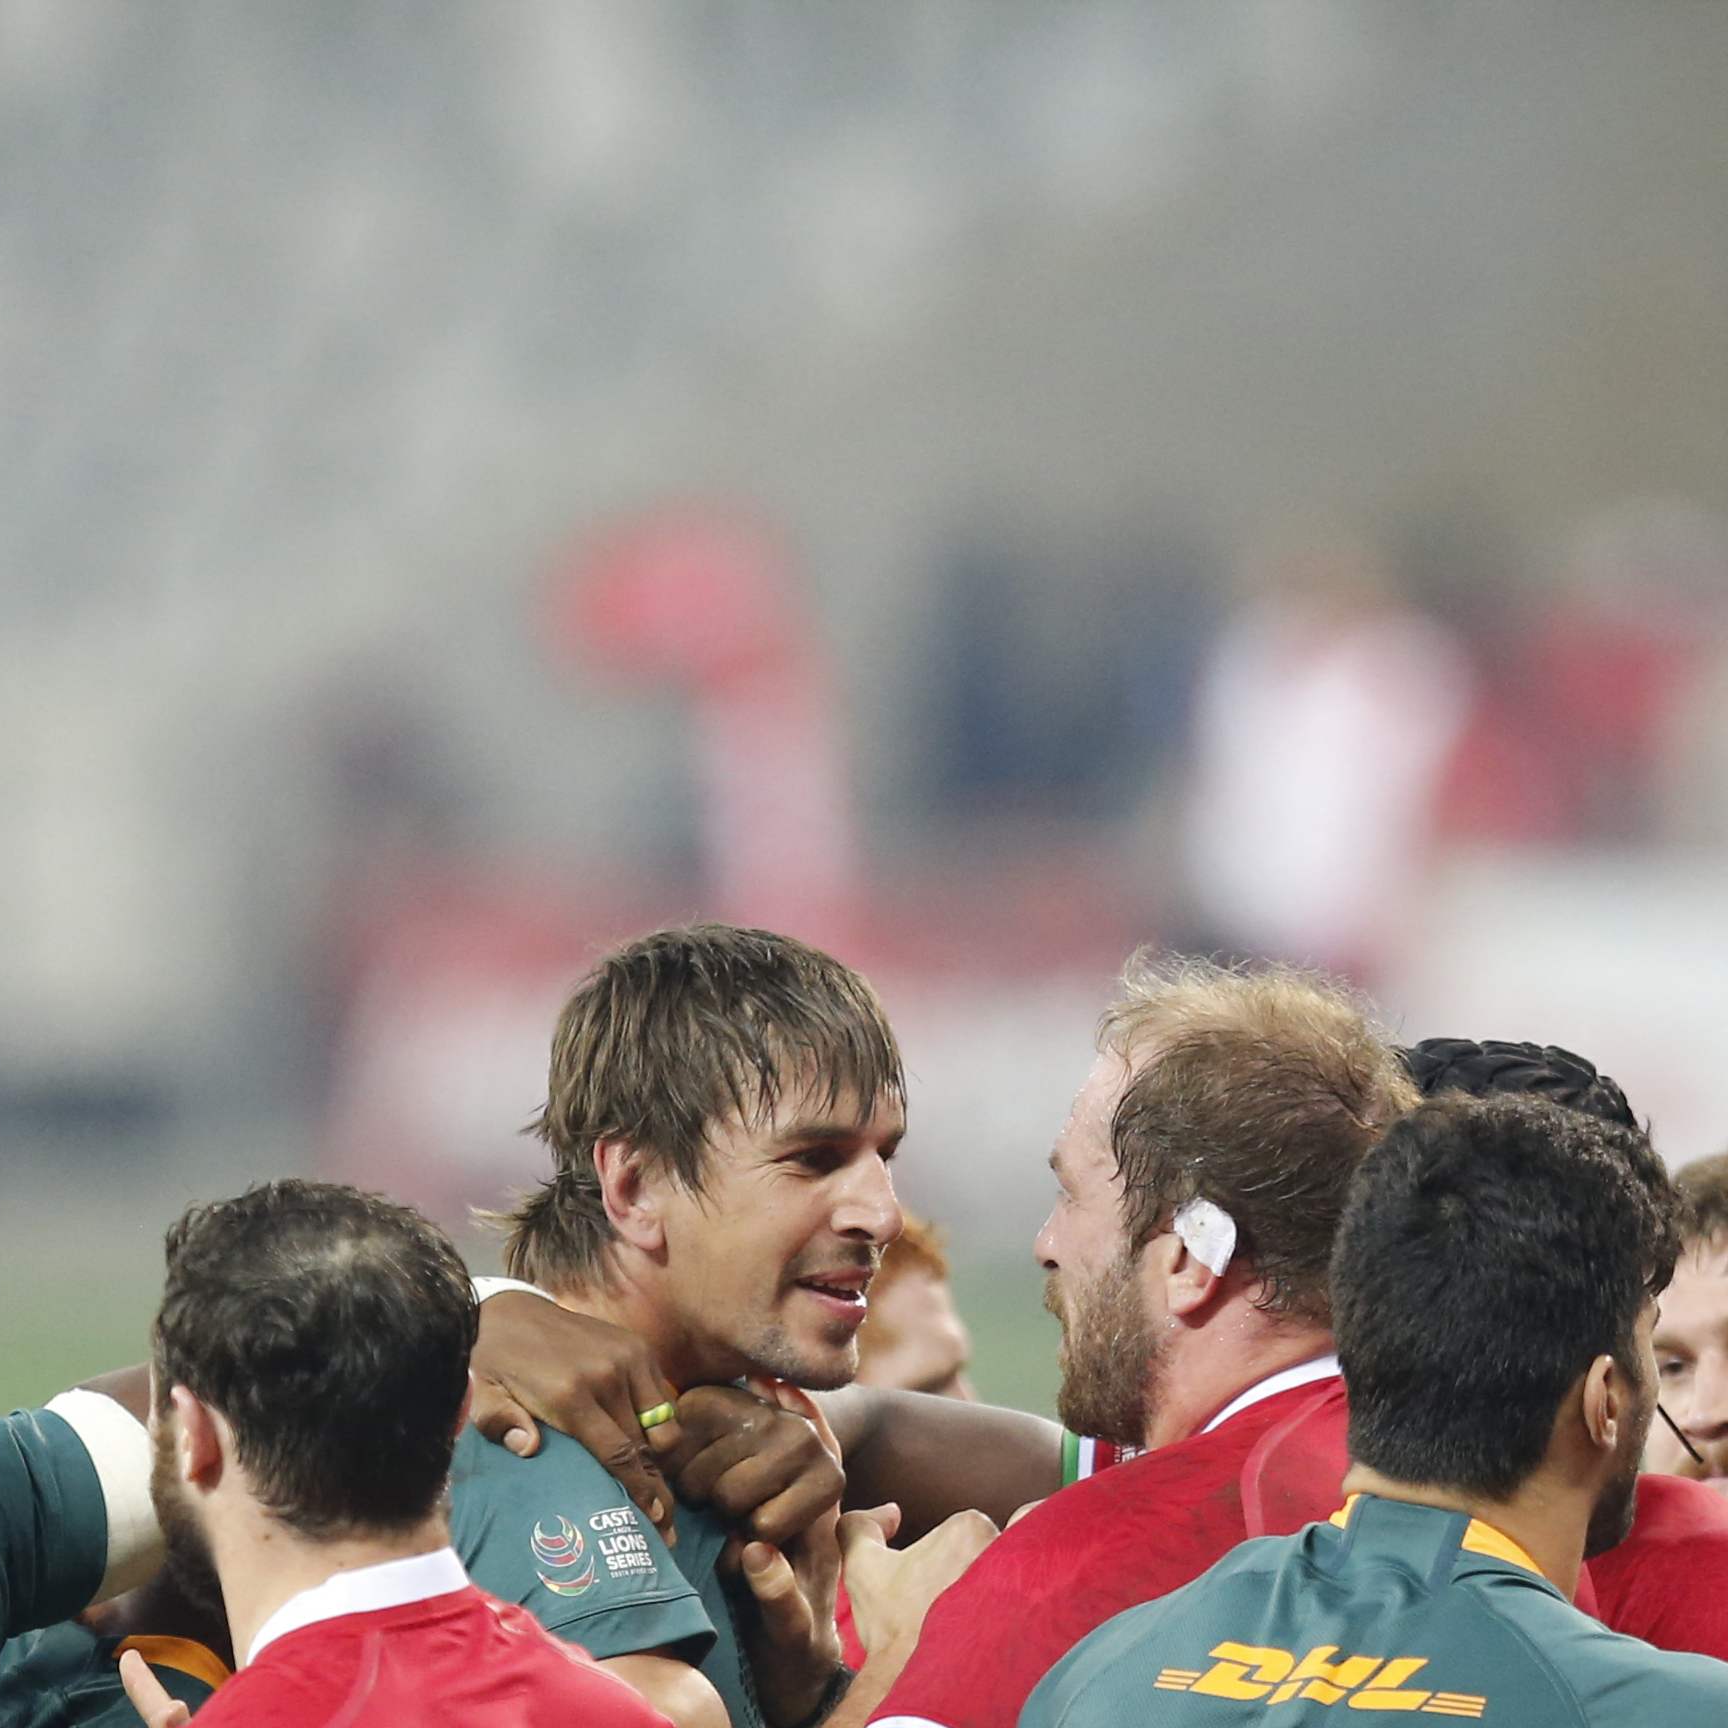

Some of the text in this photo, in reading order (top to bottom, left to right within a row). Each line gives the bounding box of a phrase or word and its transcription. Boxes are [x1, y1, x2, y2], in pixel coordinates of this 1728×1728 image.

[598, 1534, 648, 1556] LIONS
[606, 1552, 653, 1571] SERIES
[1190, 1641, 1430, 1711] DHL
